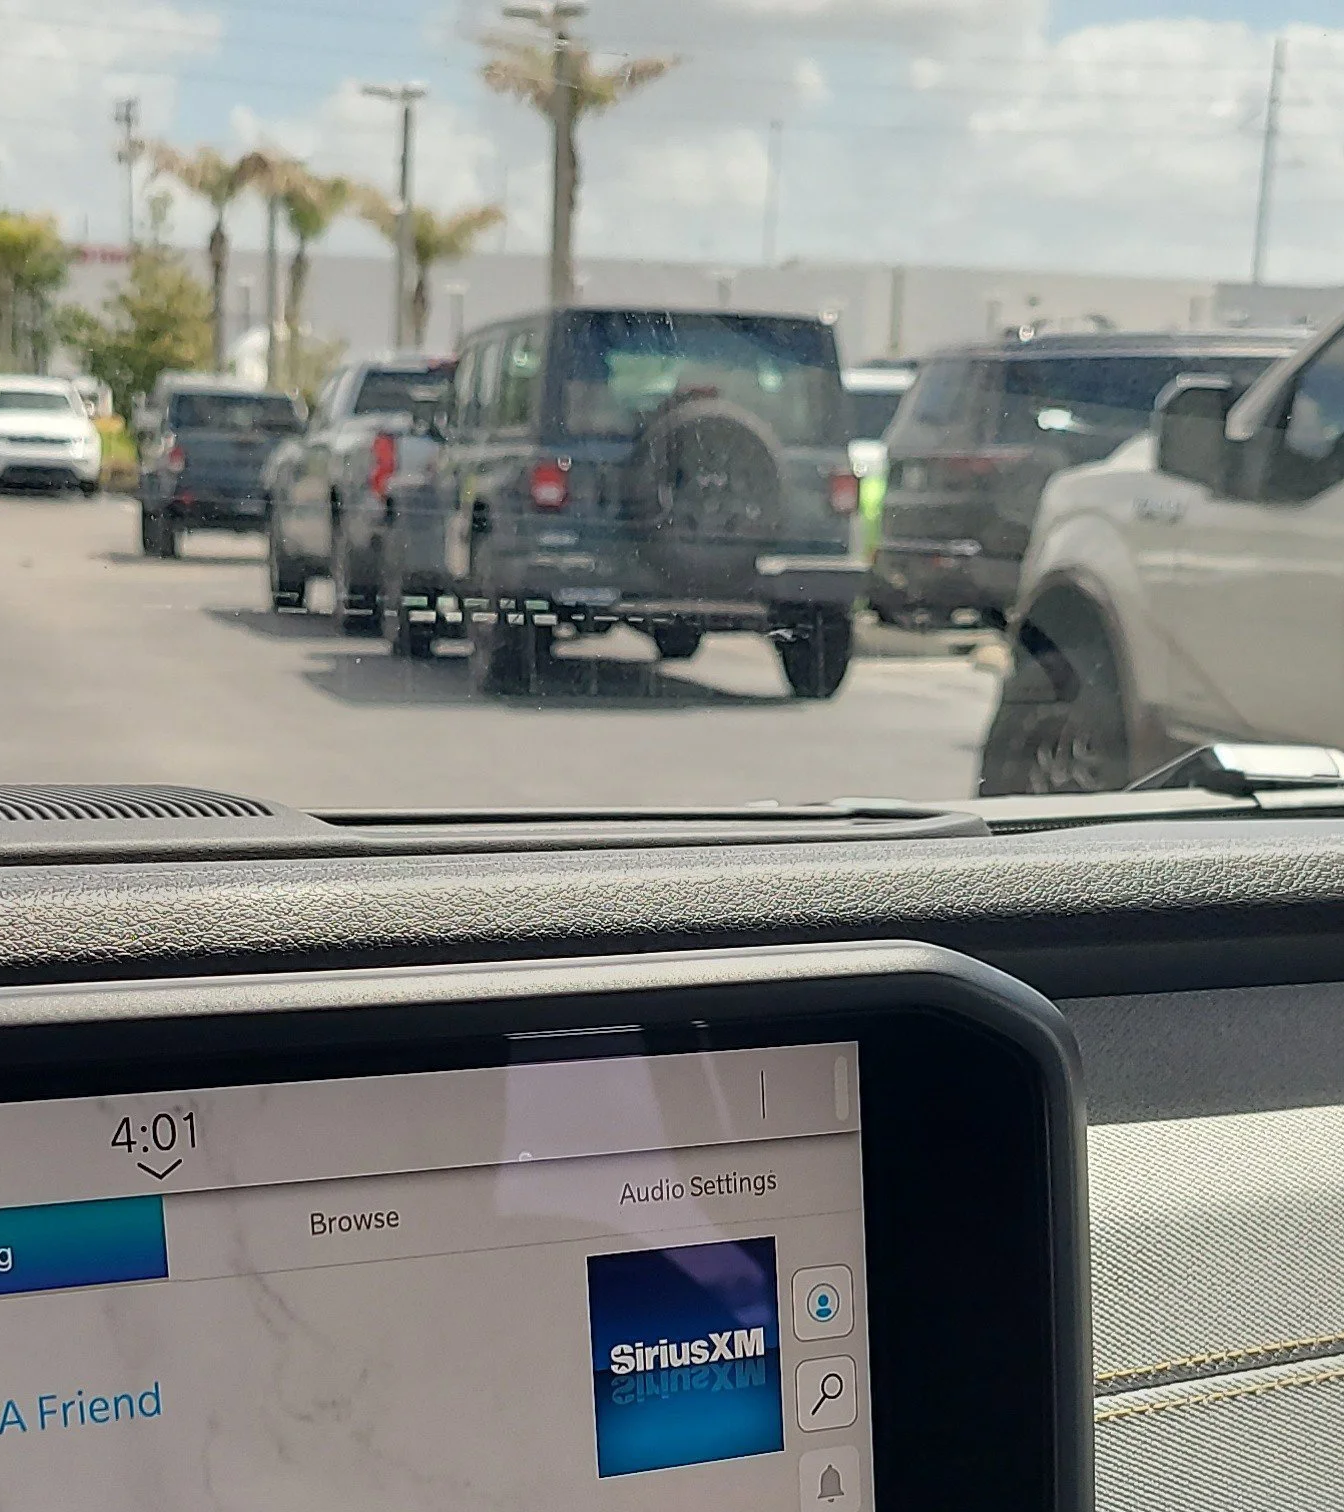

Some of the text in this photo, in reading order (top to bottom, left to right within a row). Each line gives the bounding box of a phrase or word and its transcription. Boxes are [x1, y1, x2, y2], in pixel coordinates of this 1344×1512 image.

[110, 1111, 198, 1155] 4:01
[620, 1170, 778, 1206] Audio Settings
[310, 1209, 400, 1236] Browse
[610, 1326, 765, 1375] SiriusXM
[0, 1401, 29, 1433] A
[38, 1383, 163, 1428] Friend
